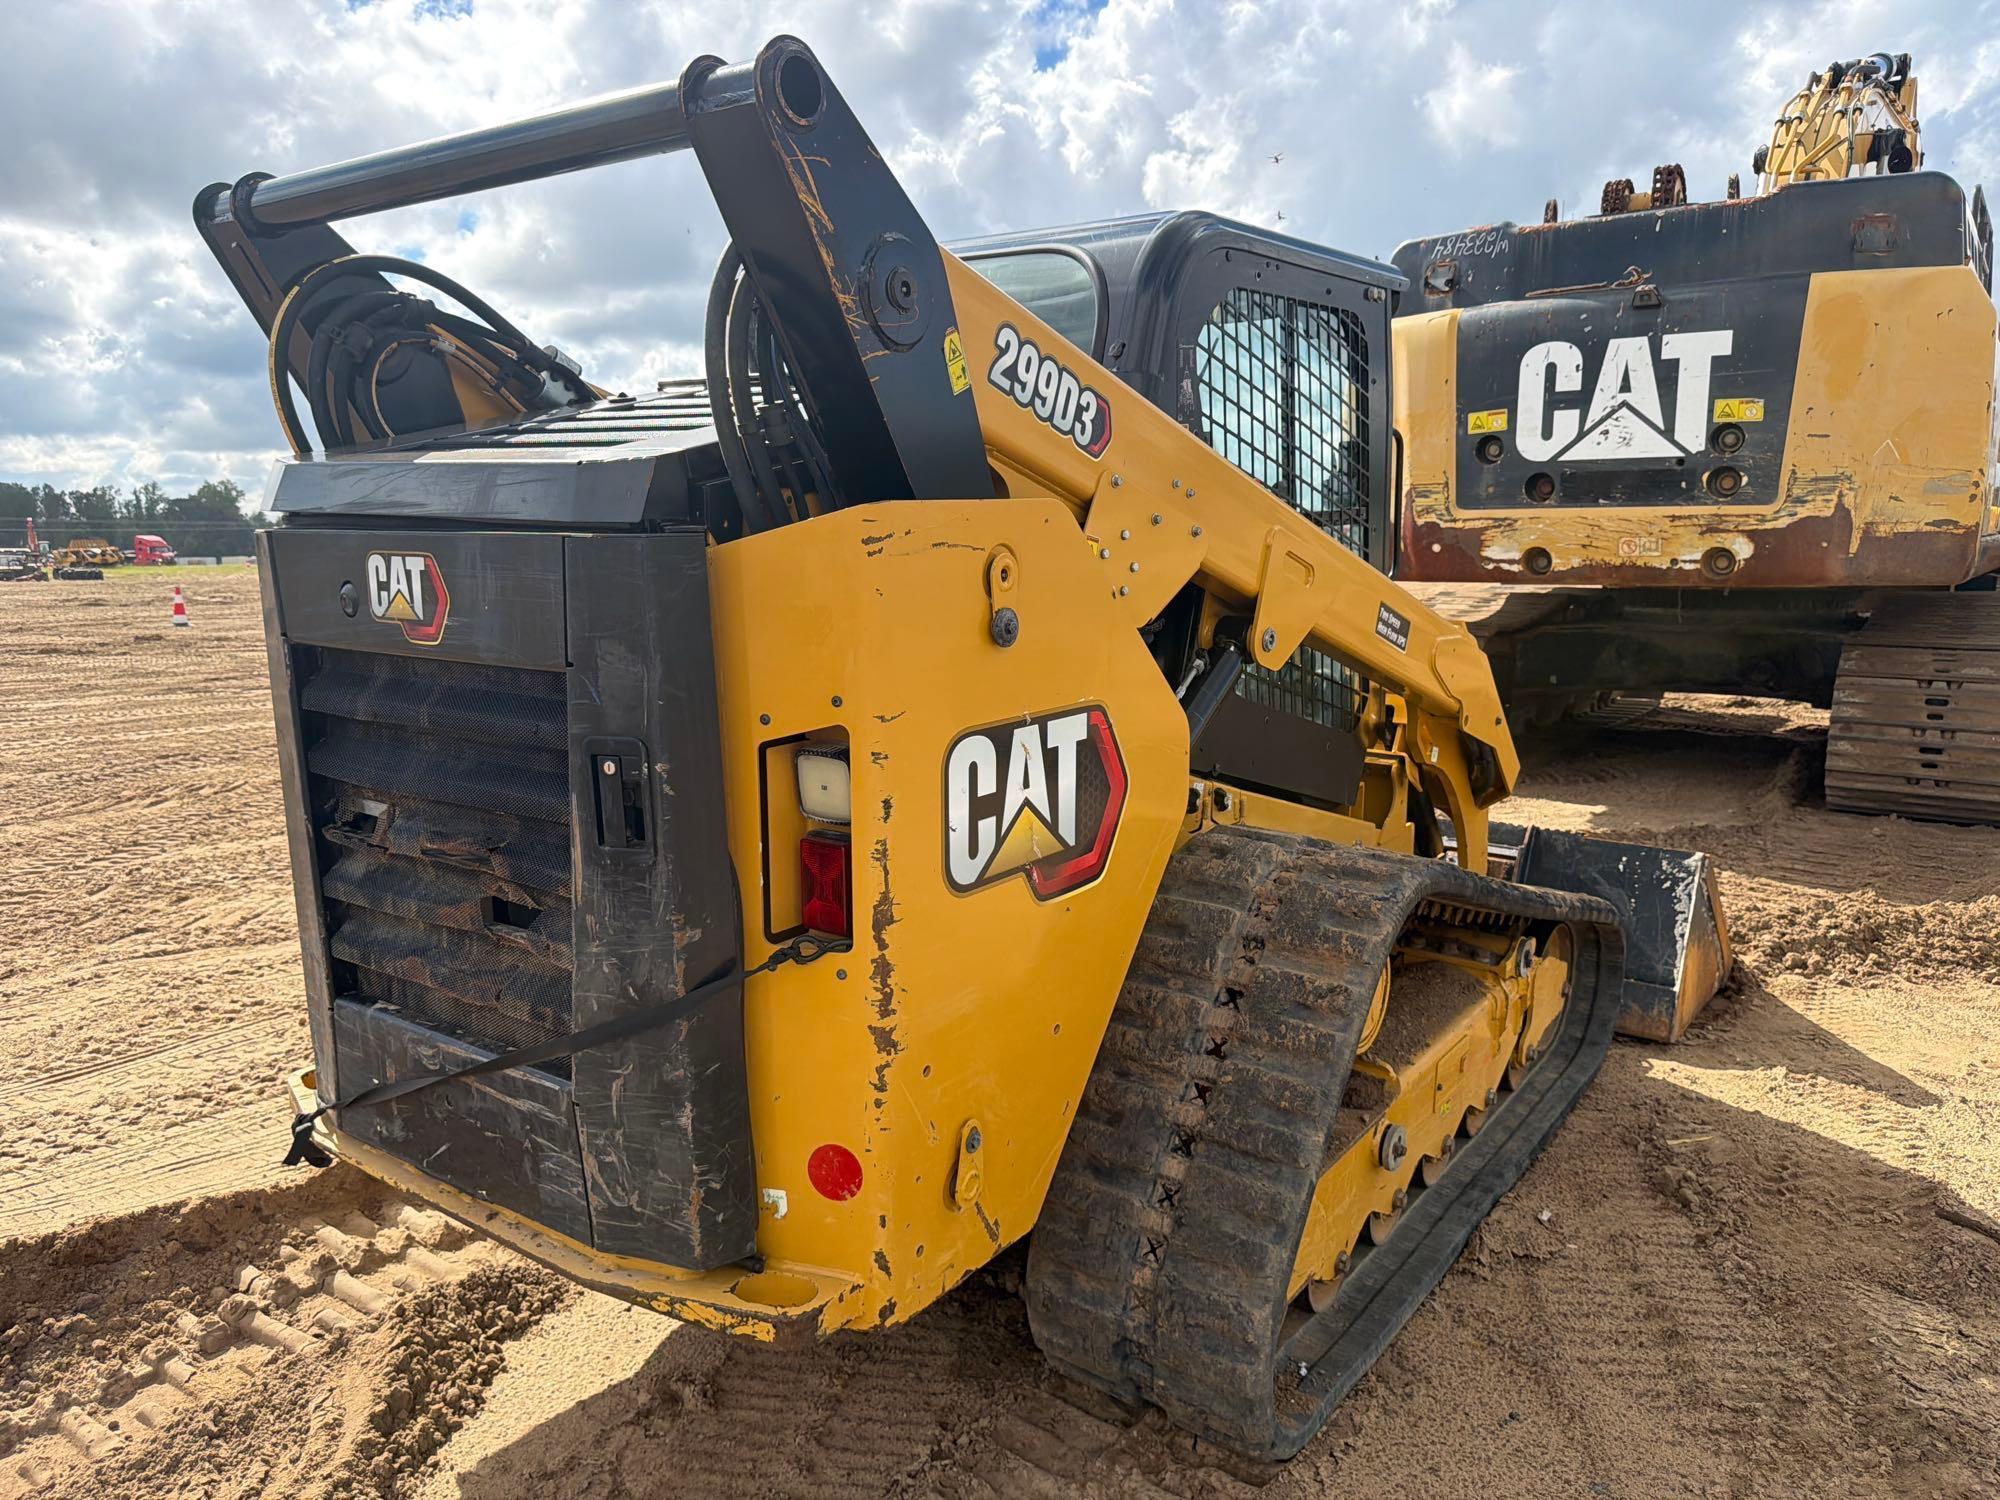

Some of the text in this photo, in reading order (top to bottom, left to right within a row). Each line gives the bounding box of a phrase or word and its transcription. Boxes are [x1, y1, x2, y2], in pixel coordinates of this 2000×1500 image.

[989, 327, 1098, 446] 299D3
[1516, 330, 1733, 462] CAT
[368, 554, 425, 621] CAT
[948, 713, 1088, 885] CAT
